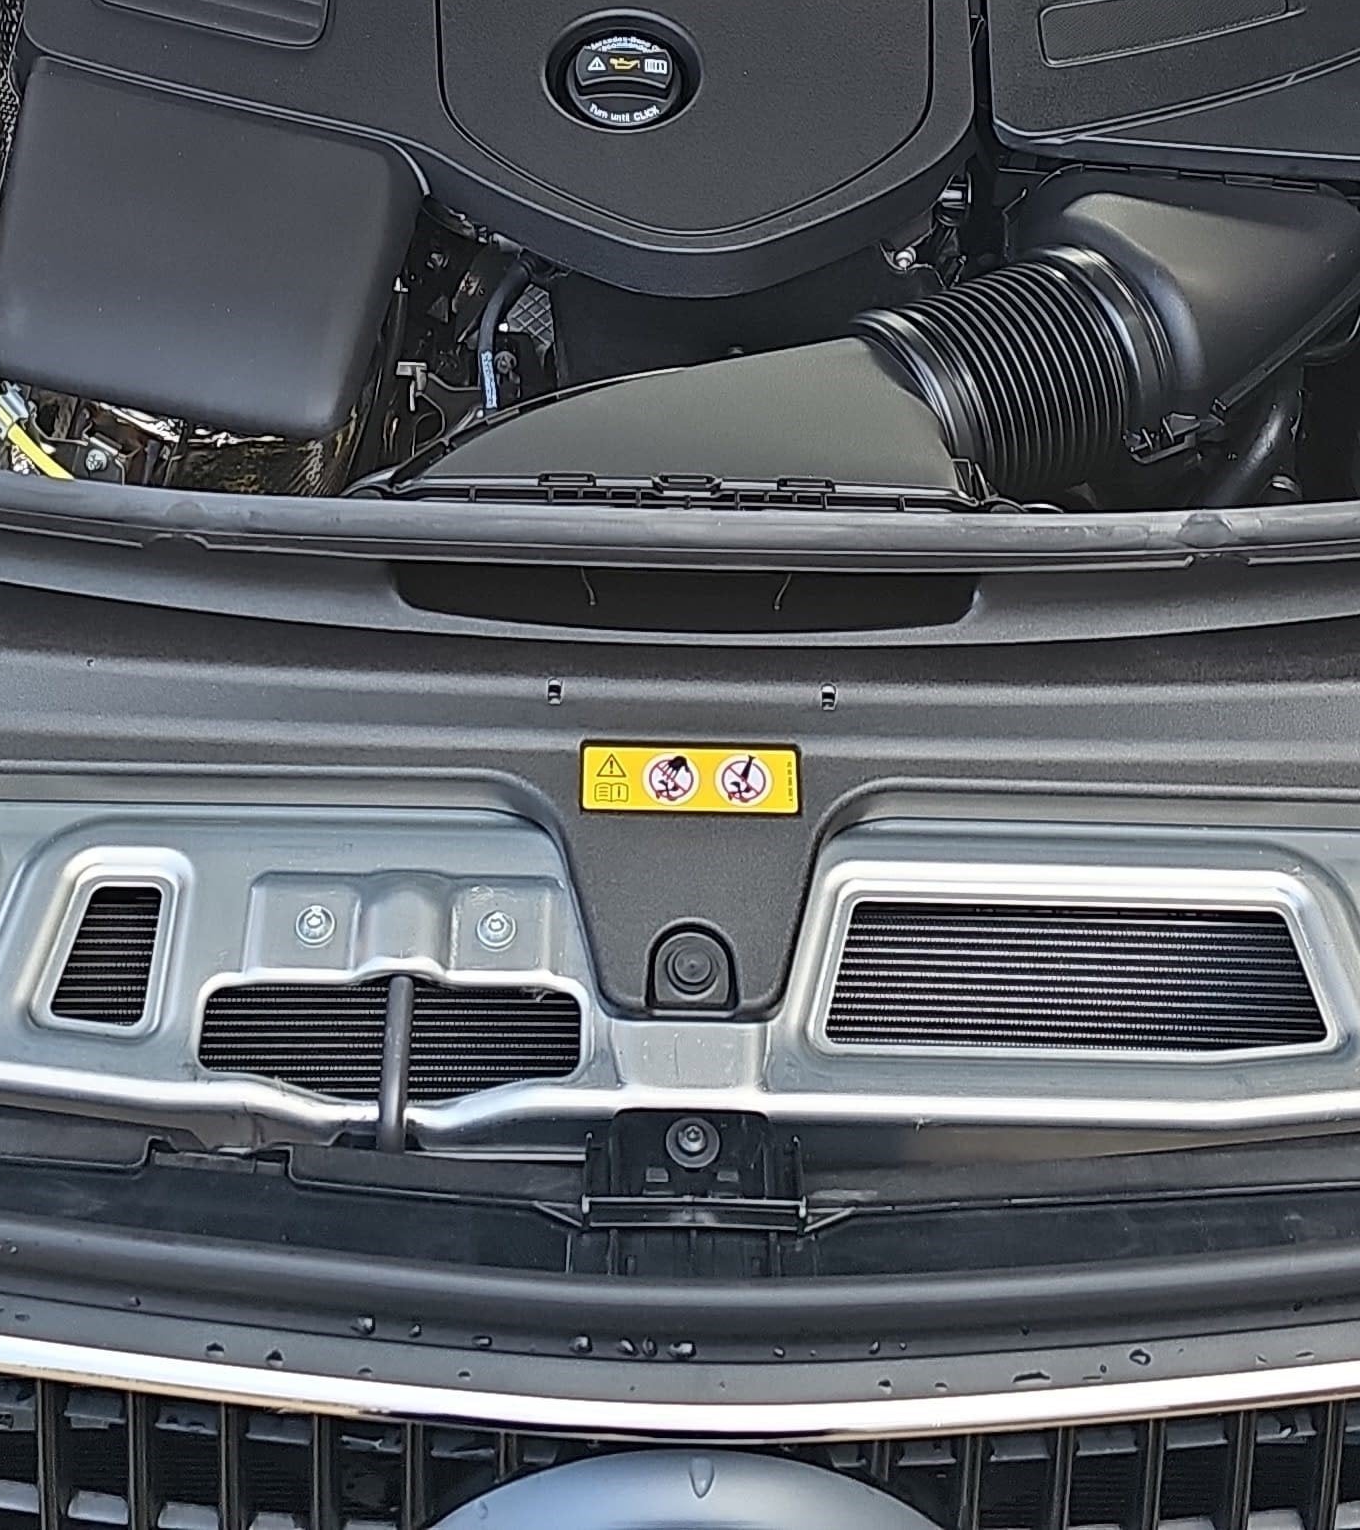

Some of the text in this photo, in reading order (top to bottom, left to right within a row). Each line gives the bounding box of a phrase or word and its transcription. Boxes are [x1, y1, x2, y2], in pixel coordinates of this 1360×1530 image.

[589, 103, 660, 122] Turn until CLICK
